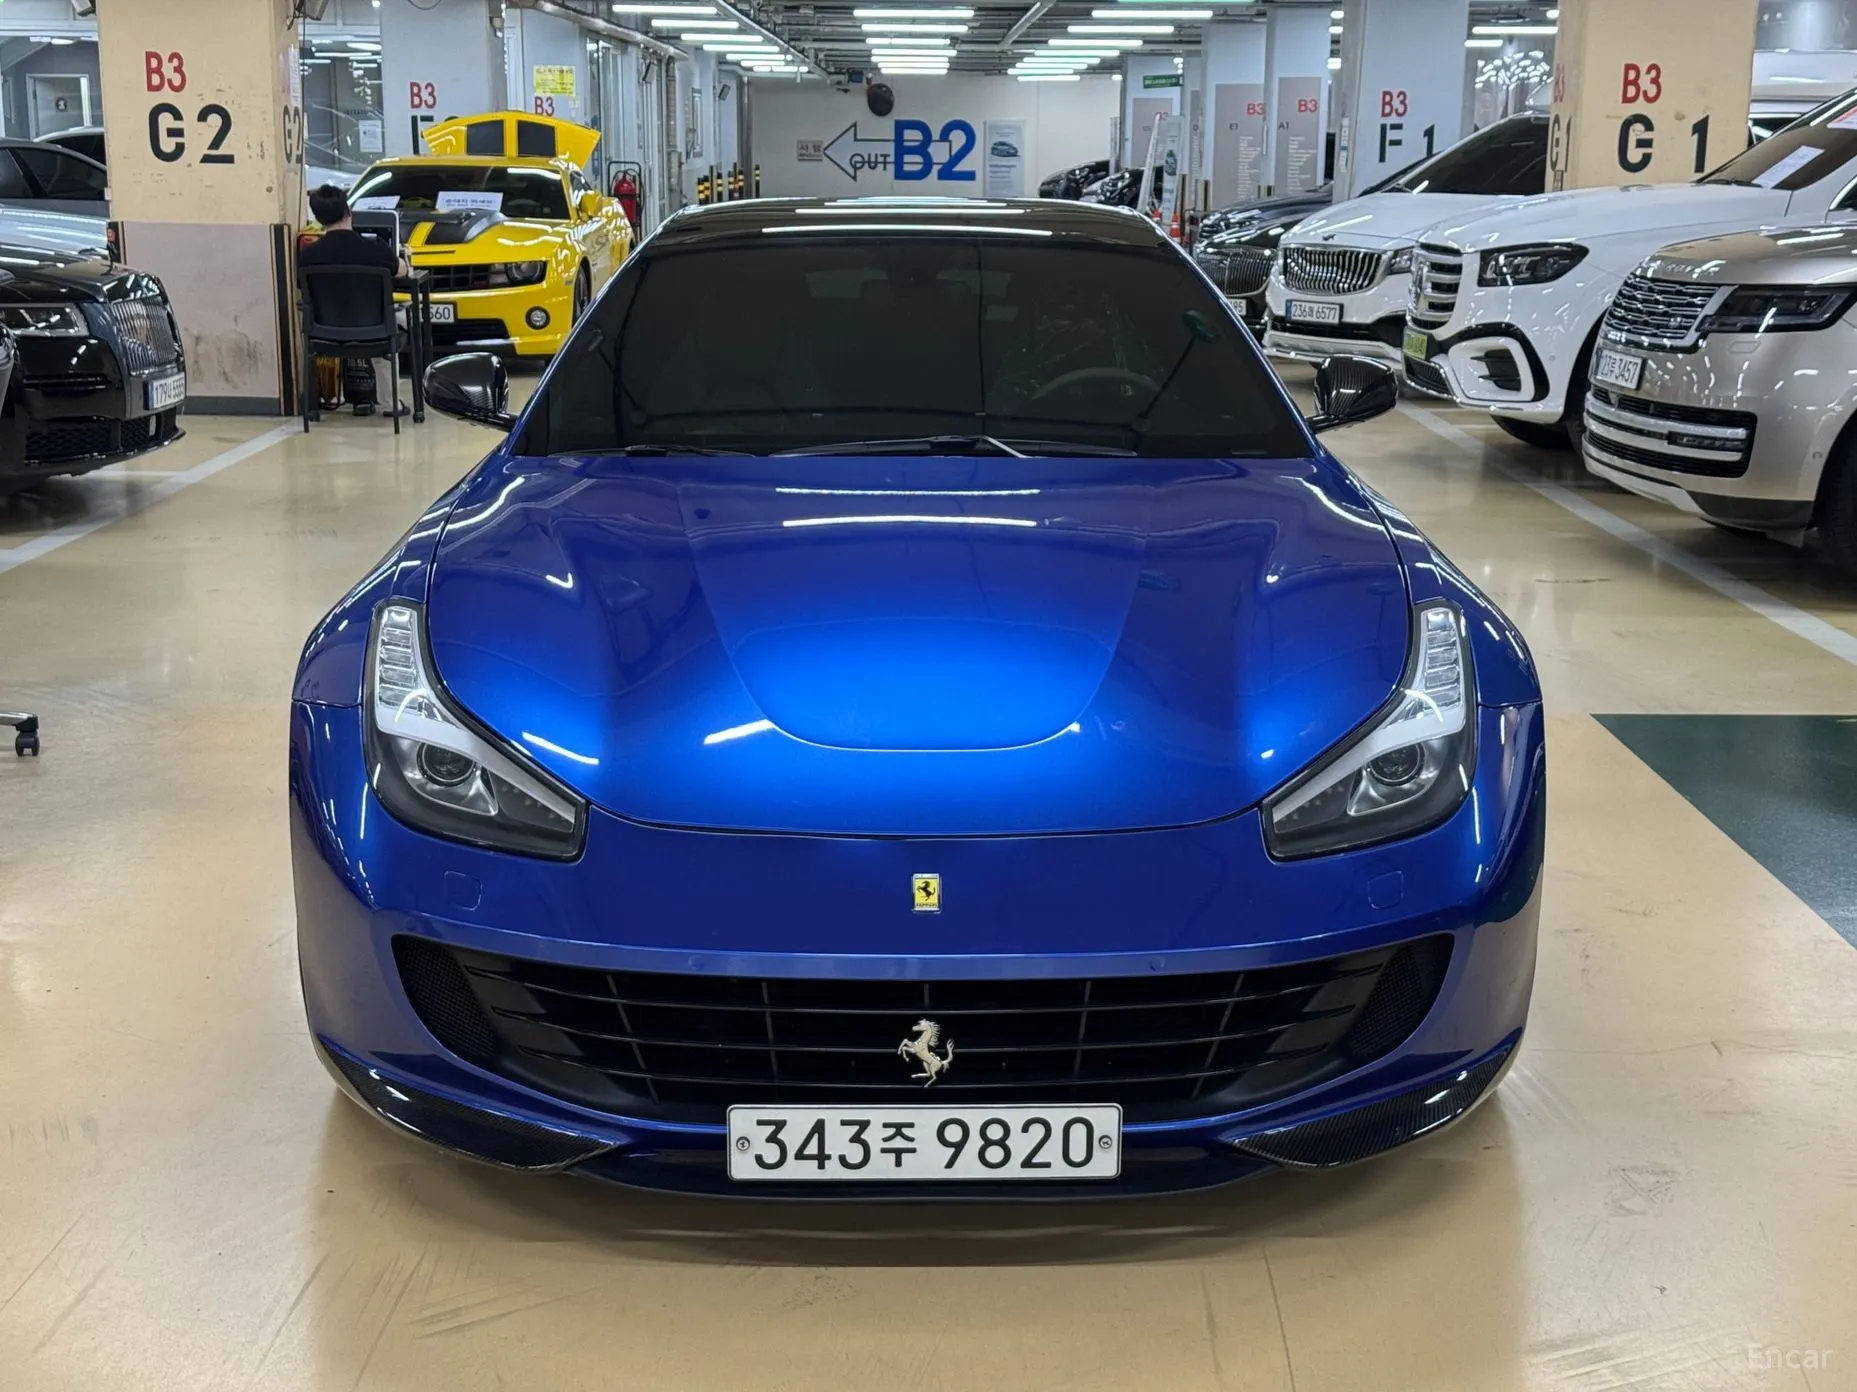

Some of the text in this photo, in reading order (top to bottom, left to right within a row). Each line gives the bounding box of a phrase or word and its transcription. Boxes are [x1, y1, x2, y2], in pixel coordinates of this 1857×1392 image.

[145, 51, 187, 93] B3
[1621, 63, 1662, 104] B3
[410, 81, 437, 109] B3
[534, 96, 555, 117] B3
[1298, 99, 1318, 112] B3
[1381, 90, 1408, 117] B3
[1246, 103, 1265, 115] B3
[1278, 121, 1290, 130] A1
[849, 119, 977, 181] OUT B2
[1315, 305, 1338, 321] 6577
[1614, 358, 1639, 384] 3457
[754, 1116, 1095, 1170] 343주 9820
